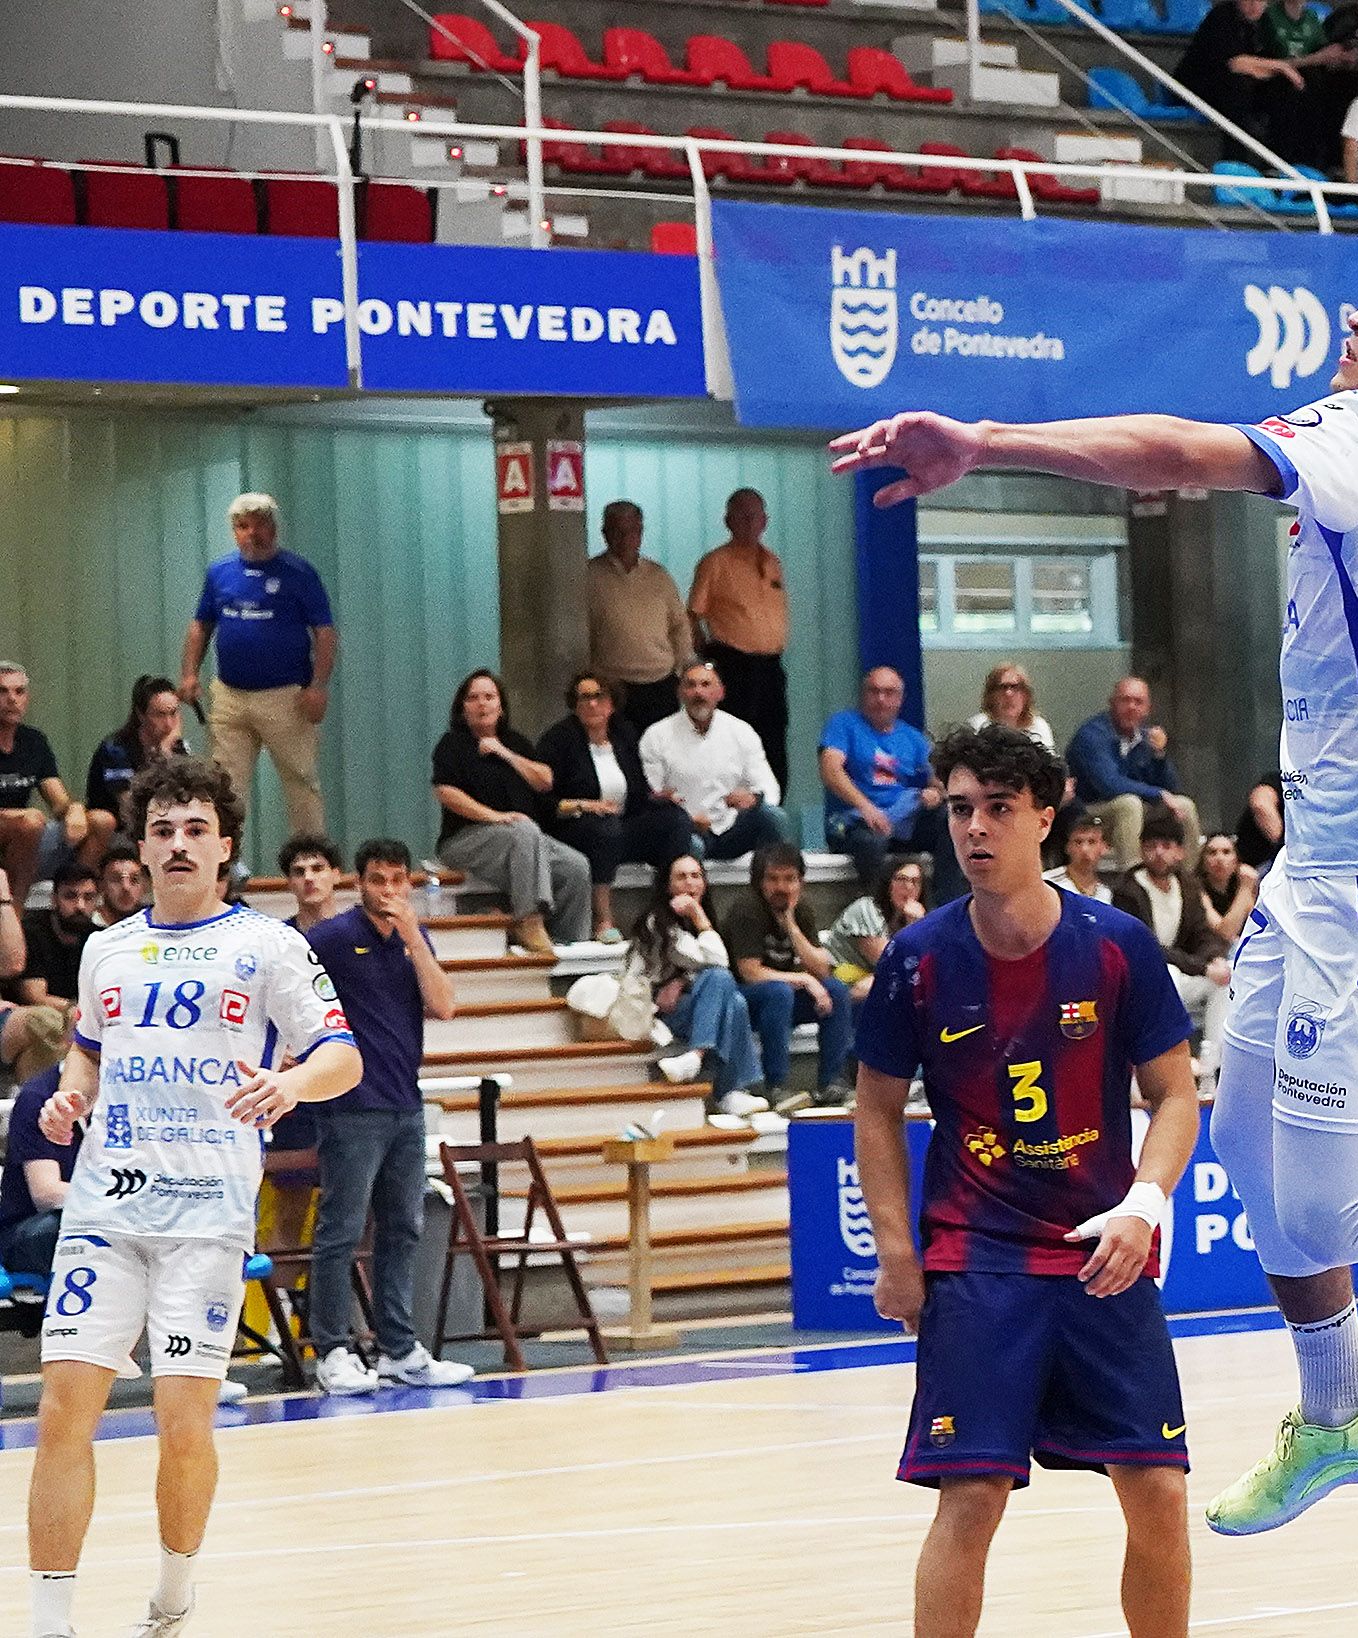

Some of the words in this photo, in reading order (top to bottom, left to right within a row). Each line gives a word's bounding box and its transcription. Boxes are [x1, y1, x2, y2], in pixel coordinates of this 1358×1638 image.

[18, 285, 288, 333] DEPORTE
[311, 297, 678, 346] PONTEVEDRA
[910, 292, 1004, 325] Concello
[911, 326, 941, 355] de
[944, 327, 1065, 361] Pontevedra
[503, 458, 527, 493] A
[552, 456, 577, 491] A
[163, 945, 218, 961] ence
[134, 979, 206, 1030] 18
[1008, 1060, 1049, 1123] 3
[1277, 1081, 1346, 1109] Pontevedra
[1278, 1068, 1347, 1097] Deputación
[136, 1107, 198, 1123] XUNTA
